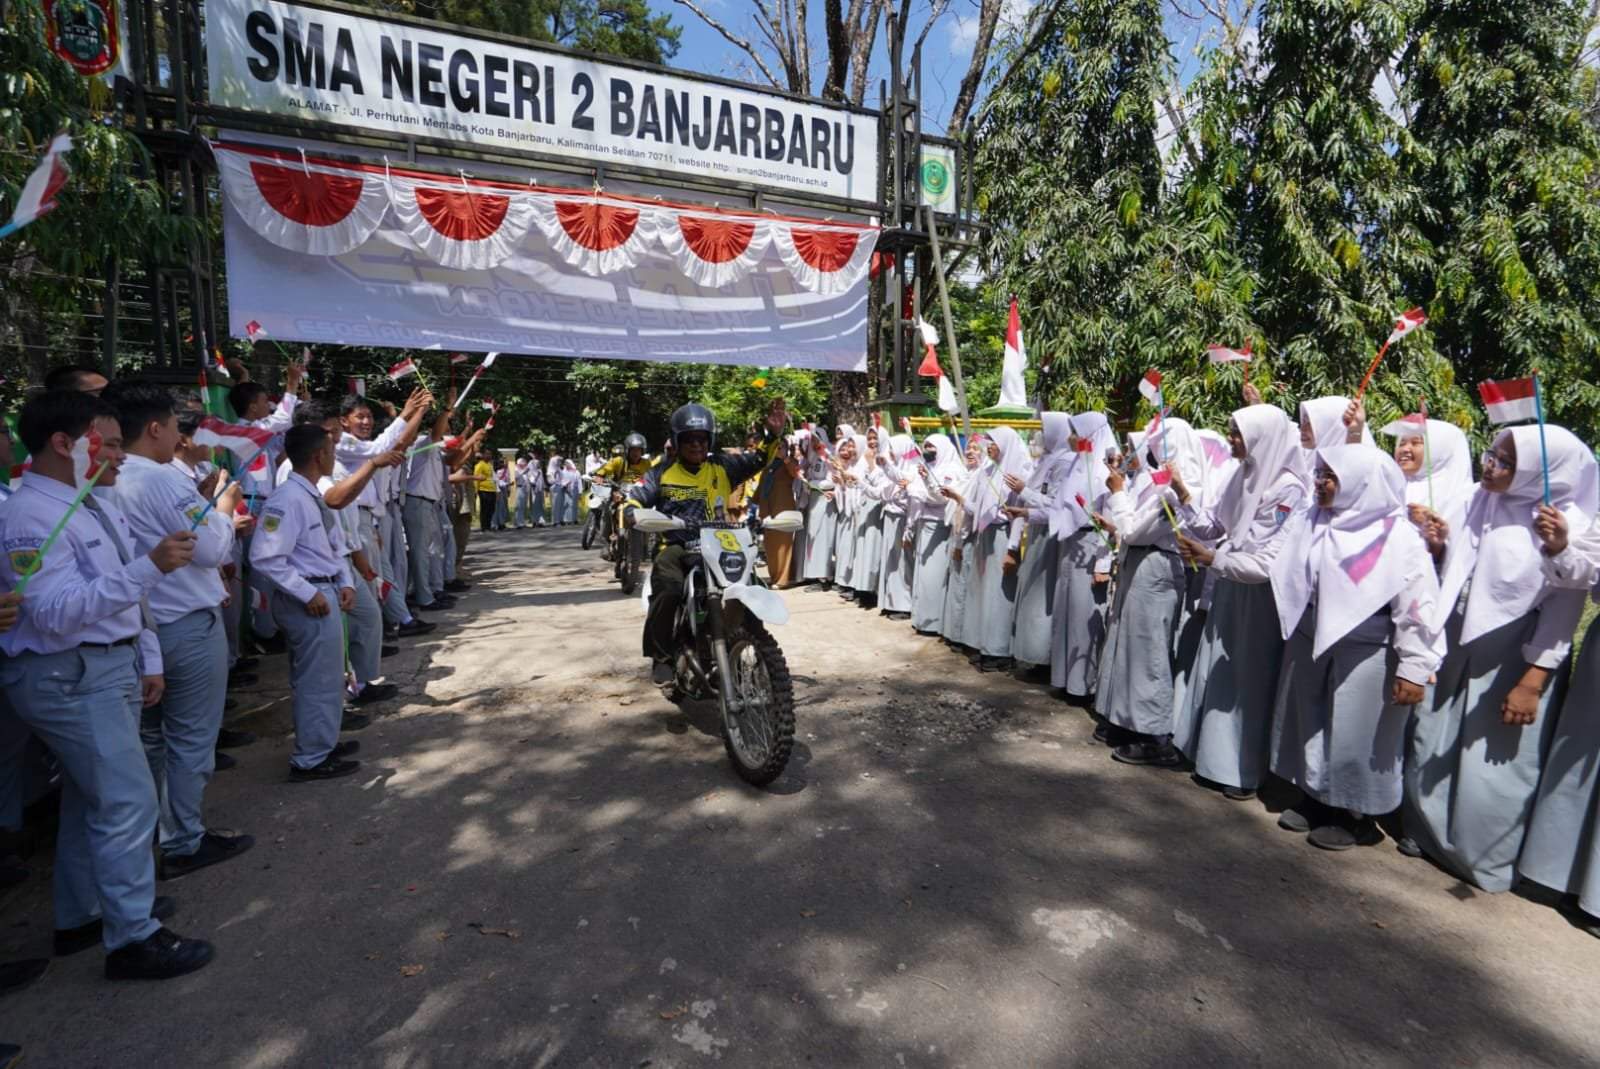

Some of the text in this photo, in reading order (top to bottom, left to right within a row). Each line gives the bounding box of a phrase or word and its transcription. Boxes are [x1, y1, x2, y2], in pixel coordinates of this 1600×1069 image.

[245, 10, 854, 175] SMA NEGERI 2 BANJARBARU
[288, 97, 339, 113] ALAMAT
[366, 108, 420, 125] Perhutani
[471, 125, 495, 138] Kota
[497, 129, 555, 147] Banjarbaru,
[557, 138, 610, 153] Kalimantan
[612, 146, 646, 159] Selatan
[648, 151, 676, 164] 70711,
[678, 156, 711, 169] website
